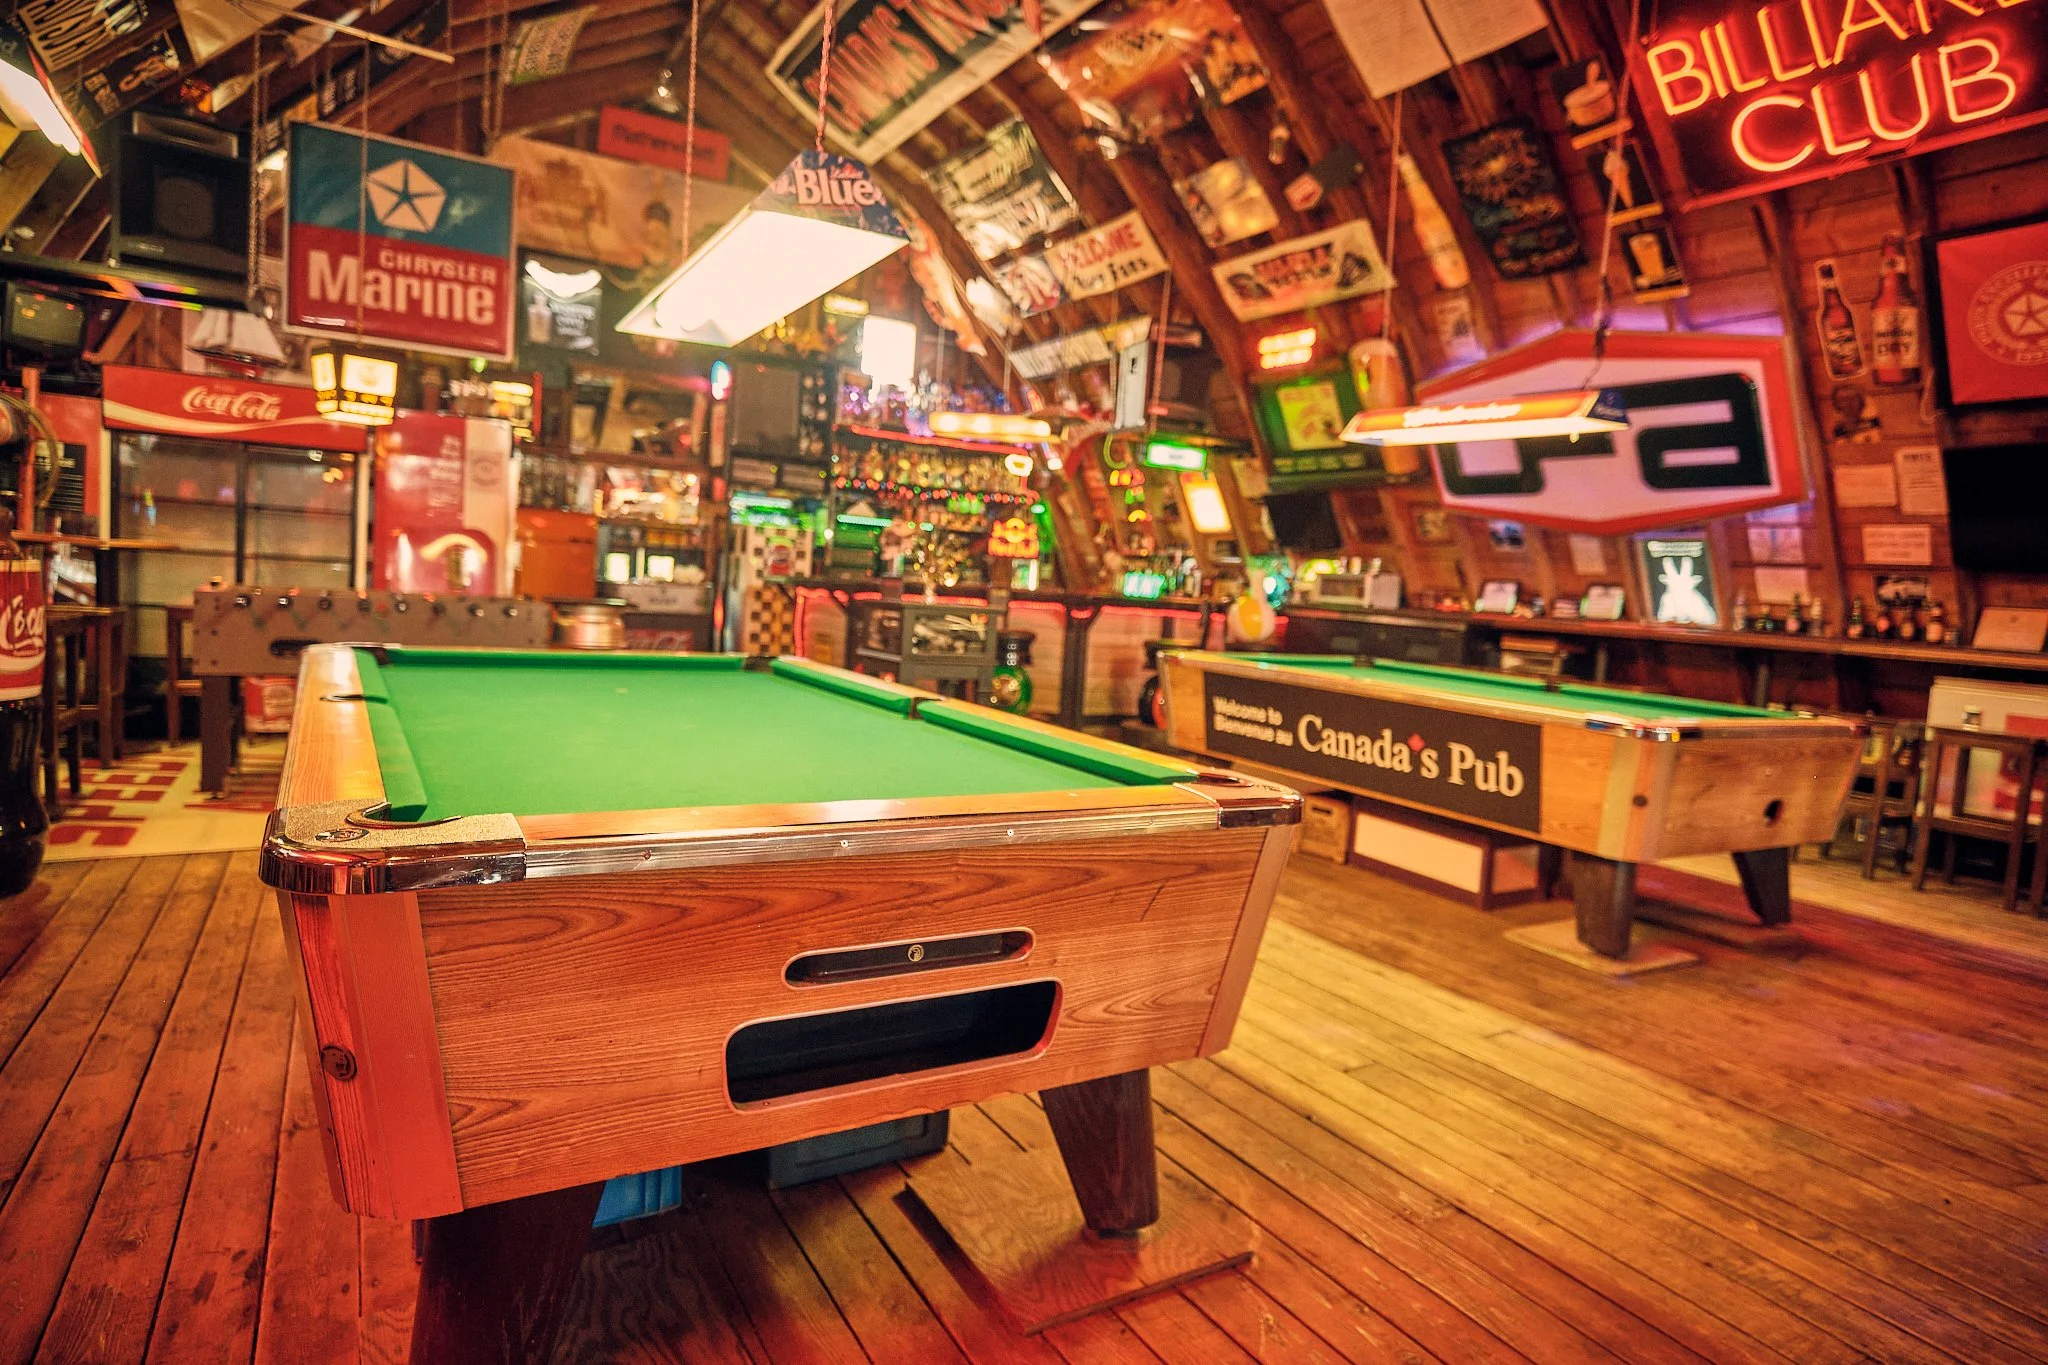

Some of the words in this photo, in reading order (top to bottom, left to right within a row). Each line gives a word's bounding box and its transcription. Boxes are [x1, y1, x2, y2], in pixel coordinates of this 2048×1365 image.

[1646, 0, 2048, 117] BILLIA
[1731, 38, 2018, 173] CLUB
[793, 167, 877, 206] Blue
[307, 249, 496, 326] Marine
[378, 249, 498, 286] CHRYSLER
[1212, 695, 1267, 723] Welcome
[1267, 706, 1283, 726] to
[1213, 713, 1275, 743] Bienvenue
[1296, 713, 1441, 780] Canada's
[1446, 740, 1526, 798] Pub
